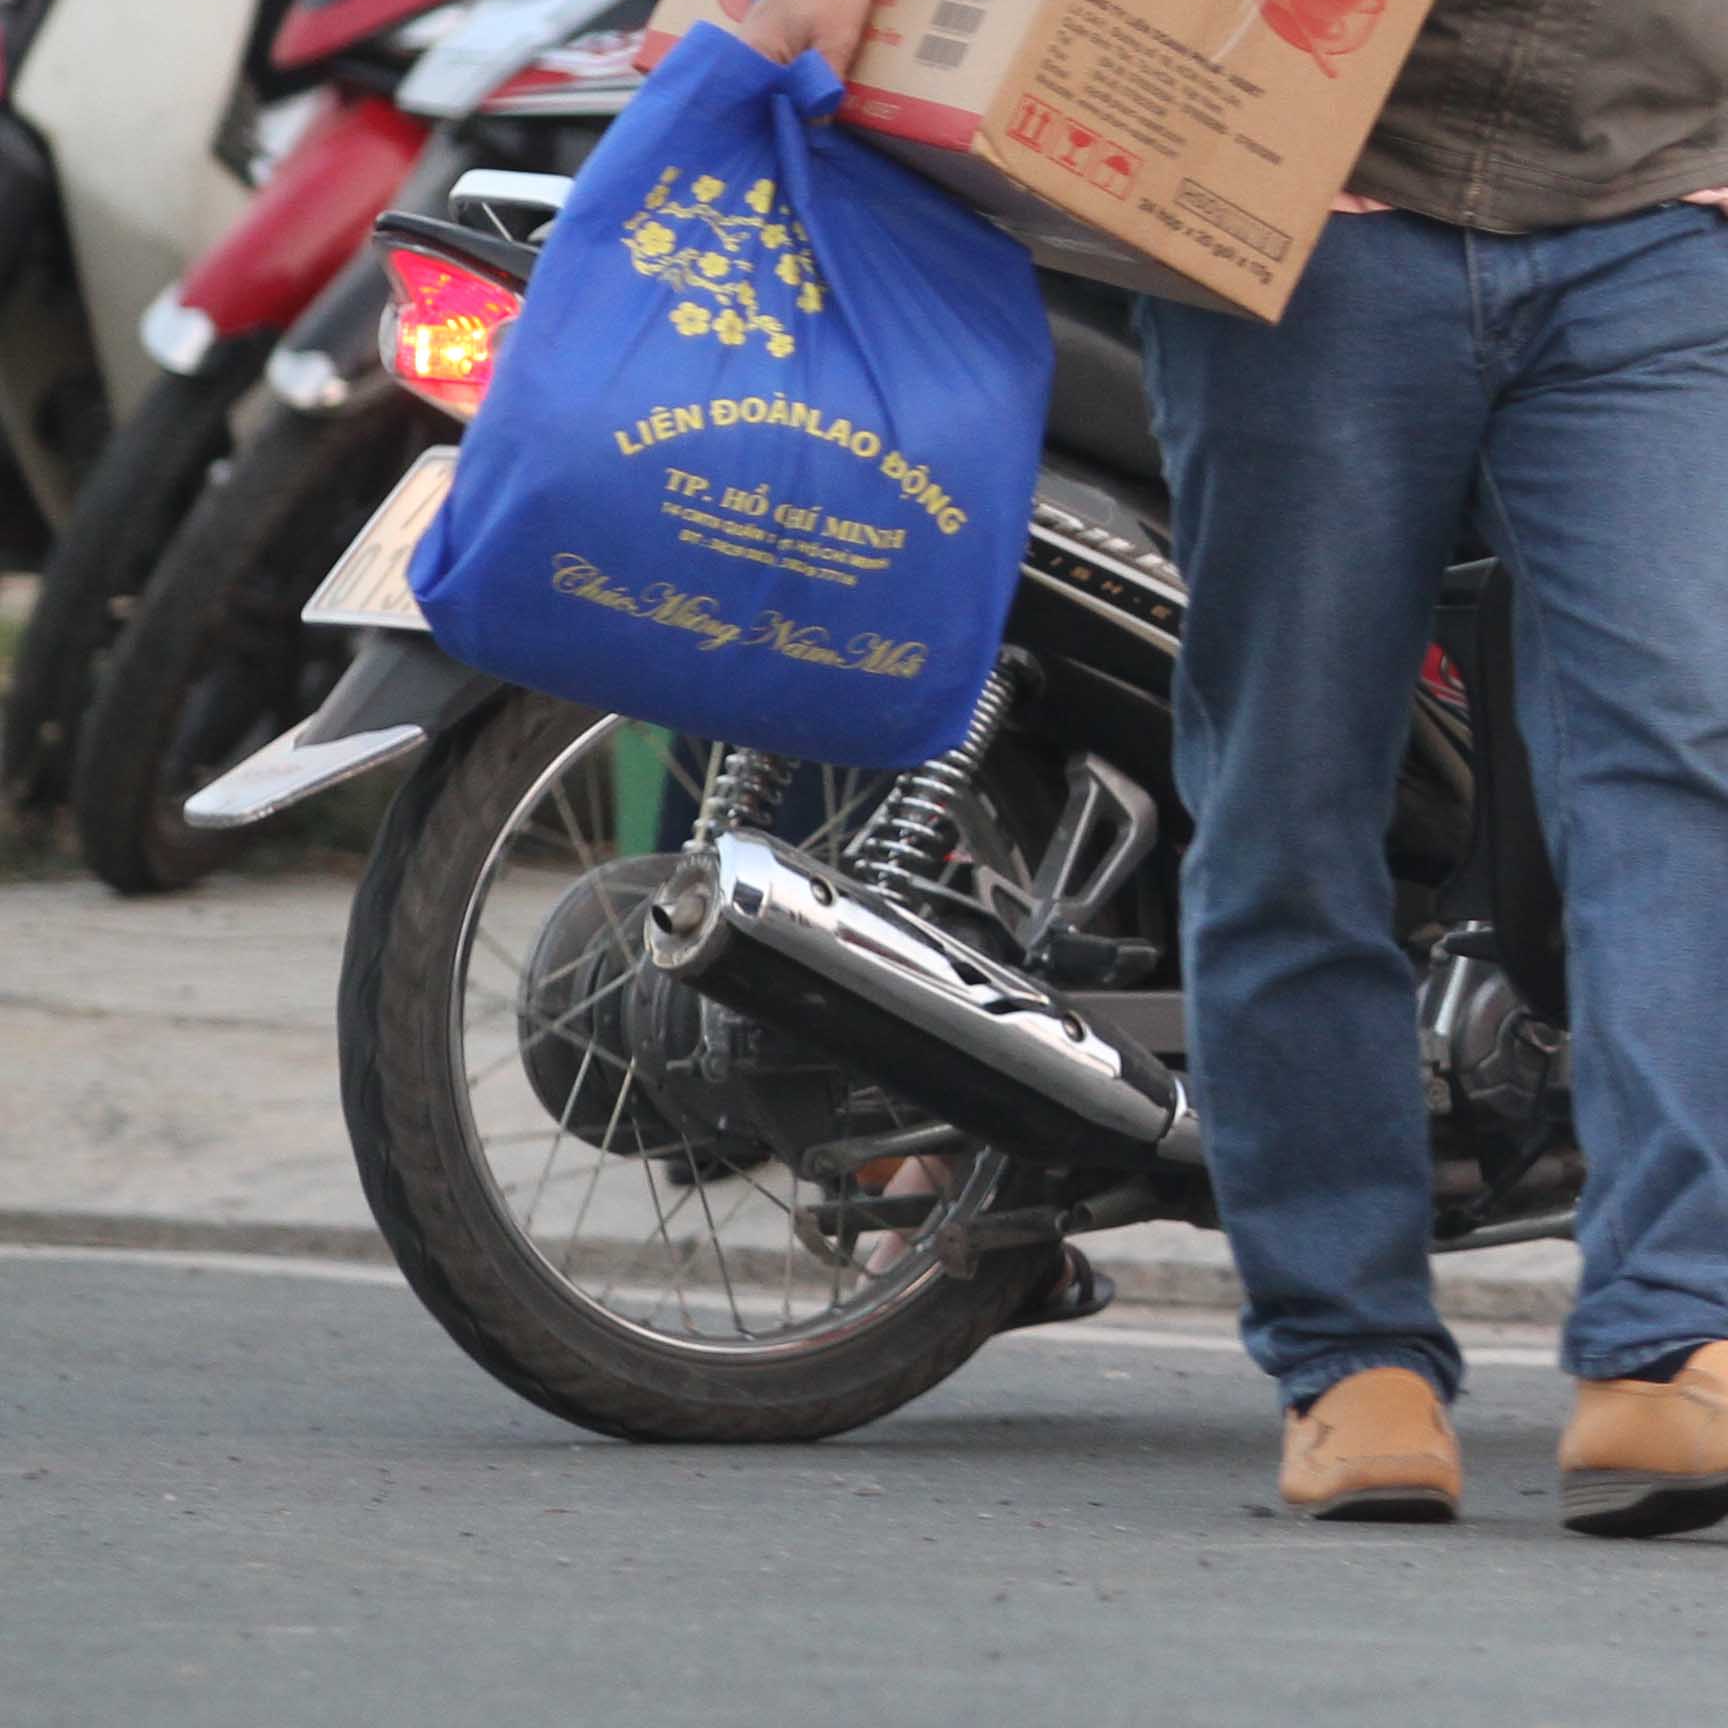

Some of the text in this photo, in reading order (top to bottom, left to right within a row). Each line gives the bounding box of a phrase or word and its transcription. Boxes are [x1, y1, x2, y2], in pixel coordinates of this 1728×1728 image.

[614, 404, 705, 456] LIÊN
[805, 409, 882, 459] LAO
[880, 450, 969, 536] ĐỘNG
[664, 467, 713, 502] TP.
[773, 505, 824, 532] CHÍ
[821, 515, 907, 549] MINH
